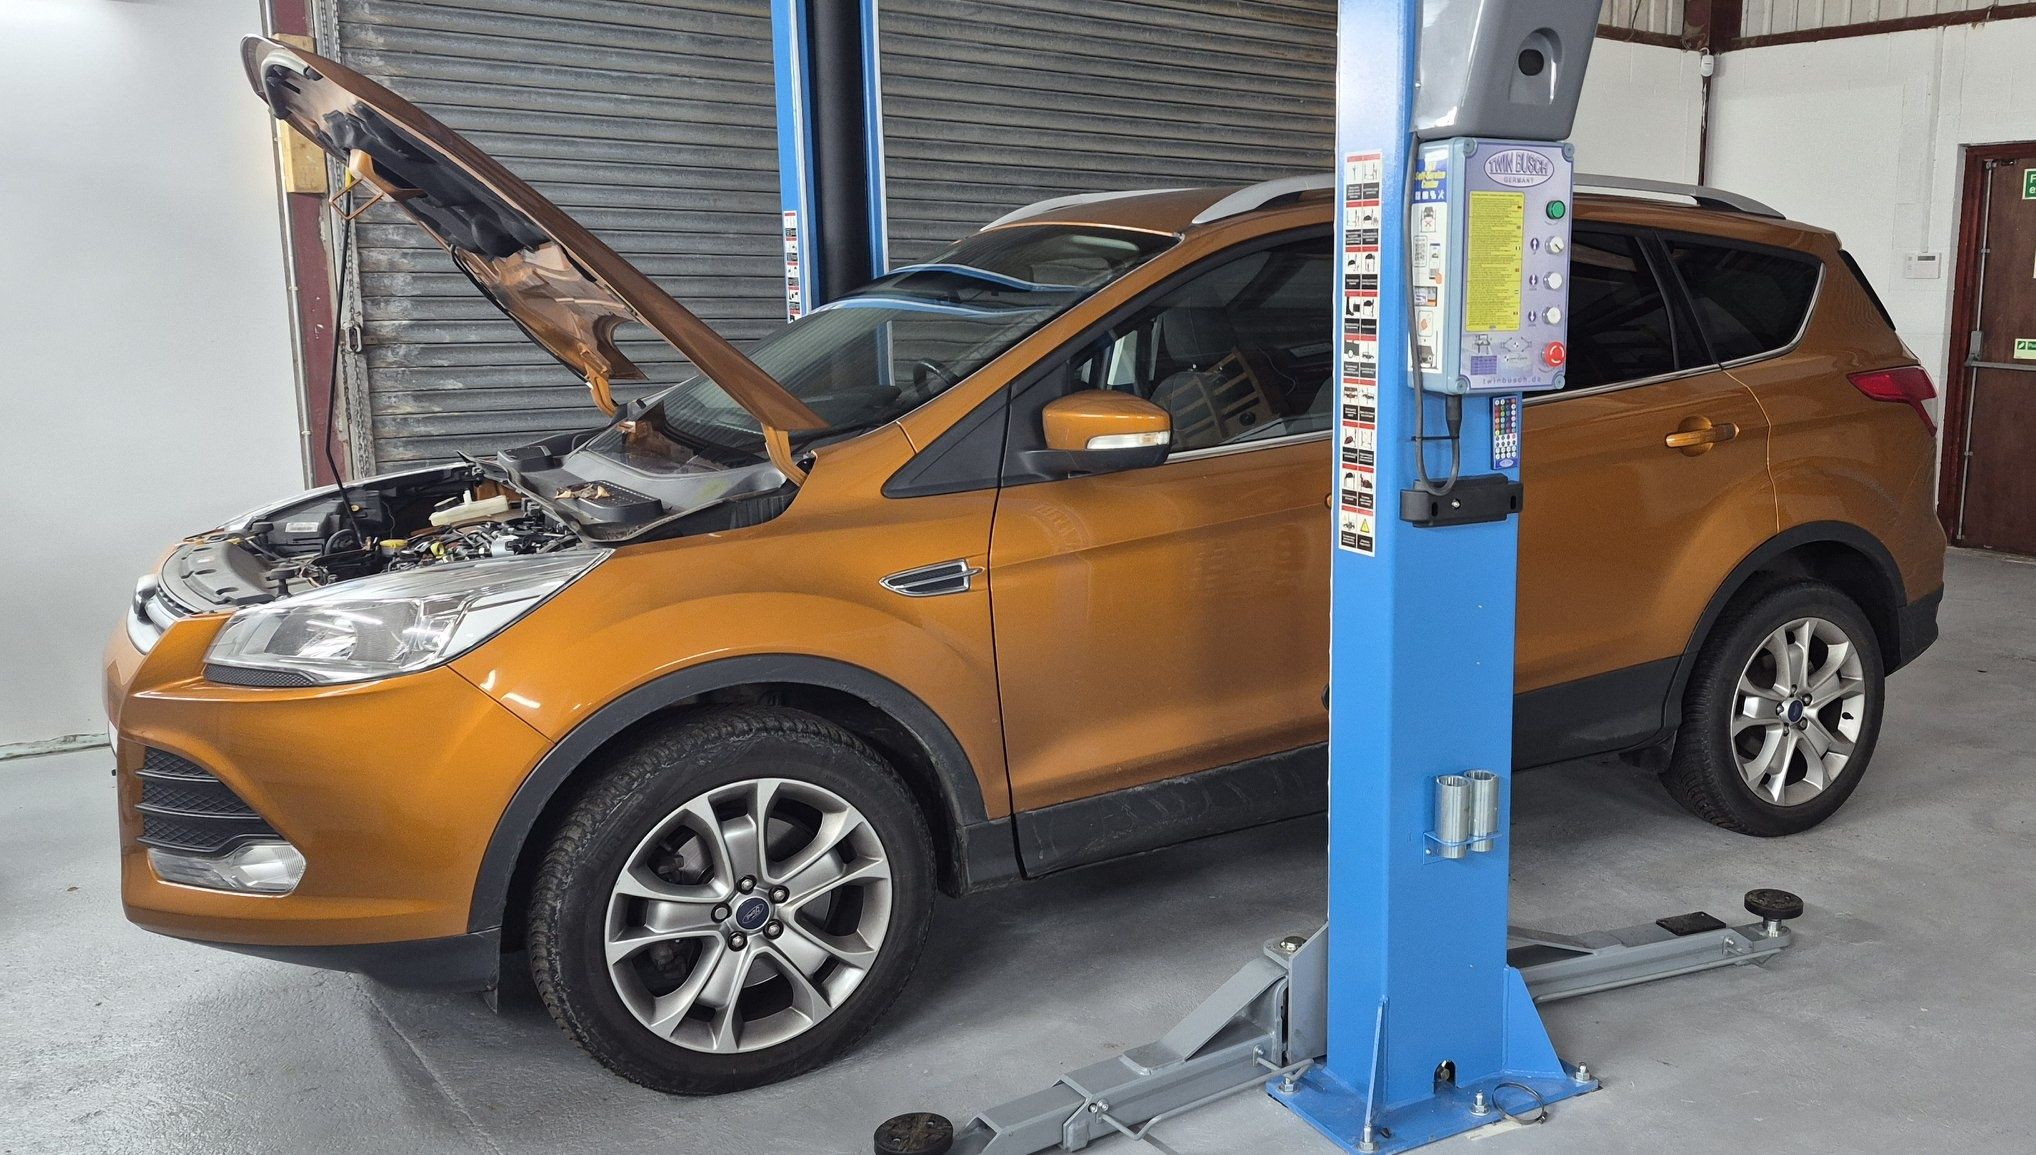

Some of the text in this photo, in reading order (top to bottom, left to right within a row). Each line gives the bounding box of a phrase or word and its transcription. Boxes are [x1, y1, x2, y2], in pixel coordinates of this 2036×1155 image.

[1488, 152, 1548, 174] TWIN BUSCH
[1503, 176, 1534, 184] GERMANY
